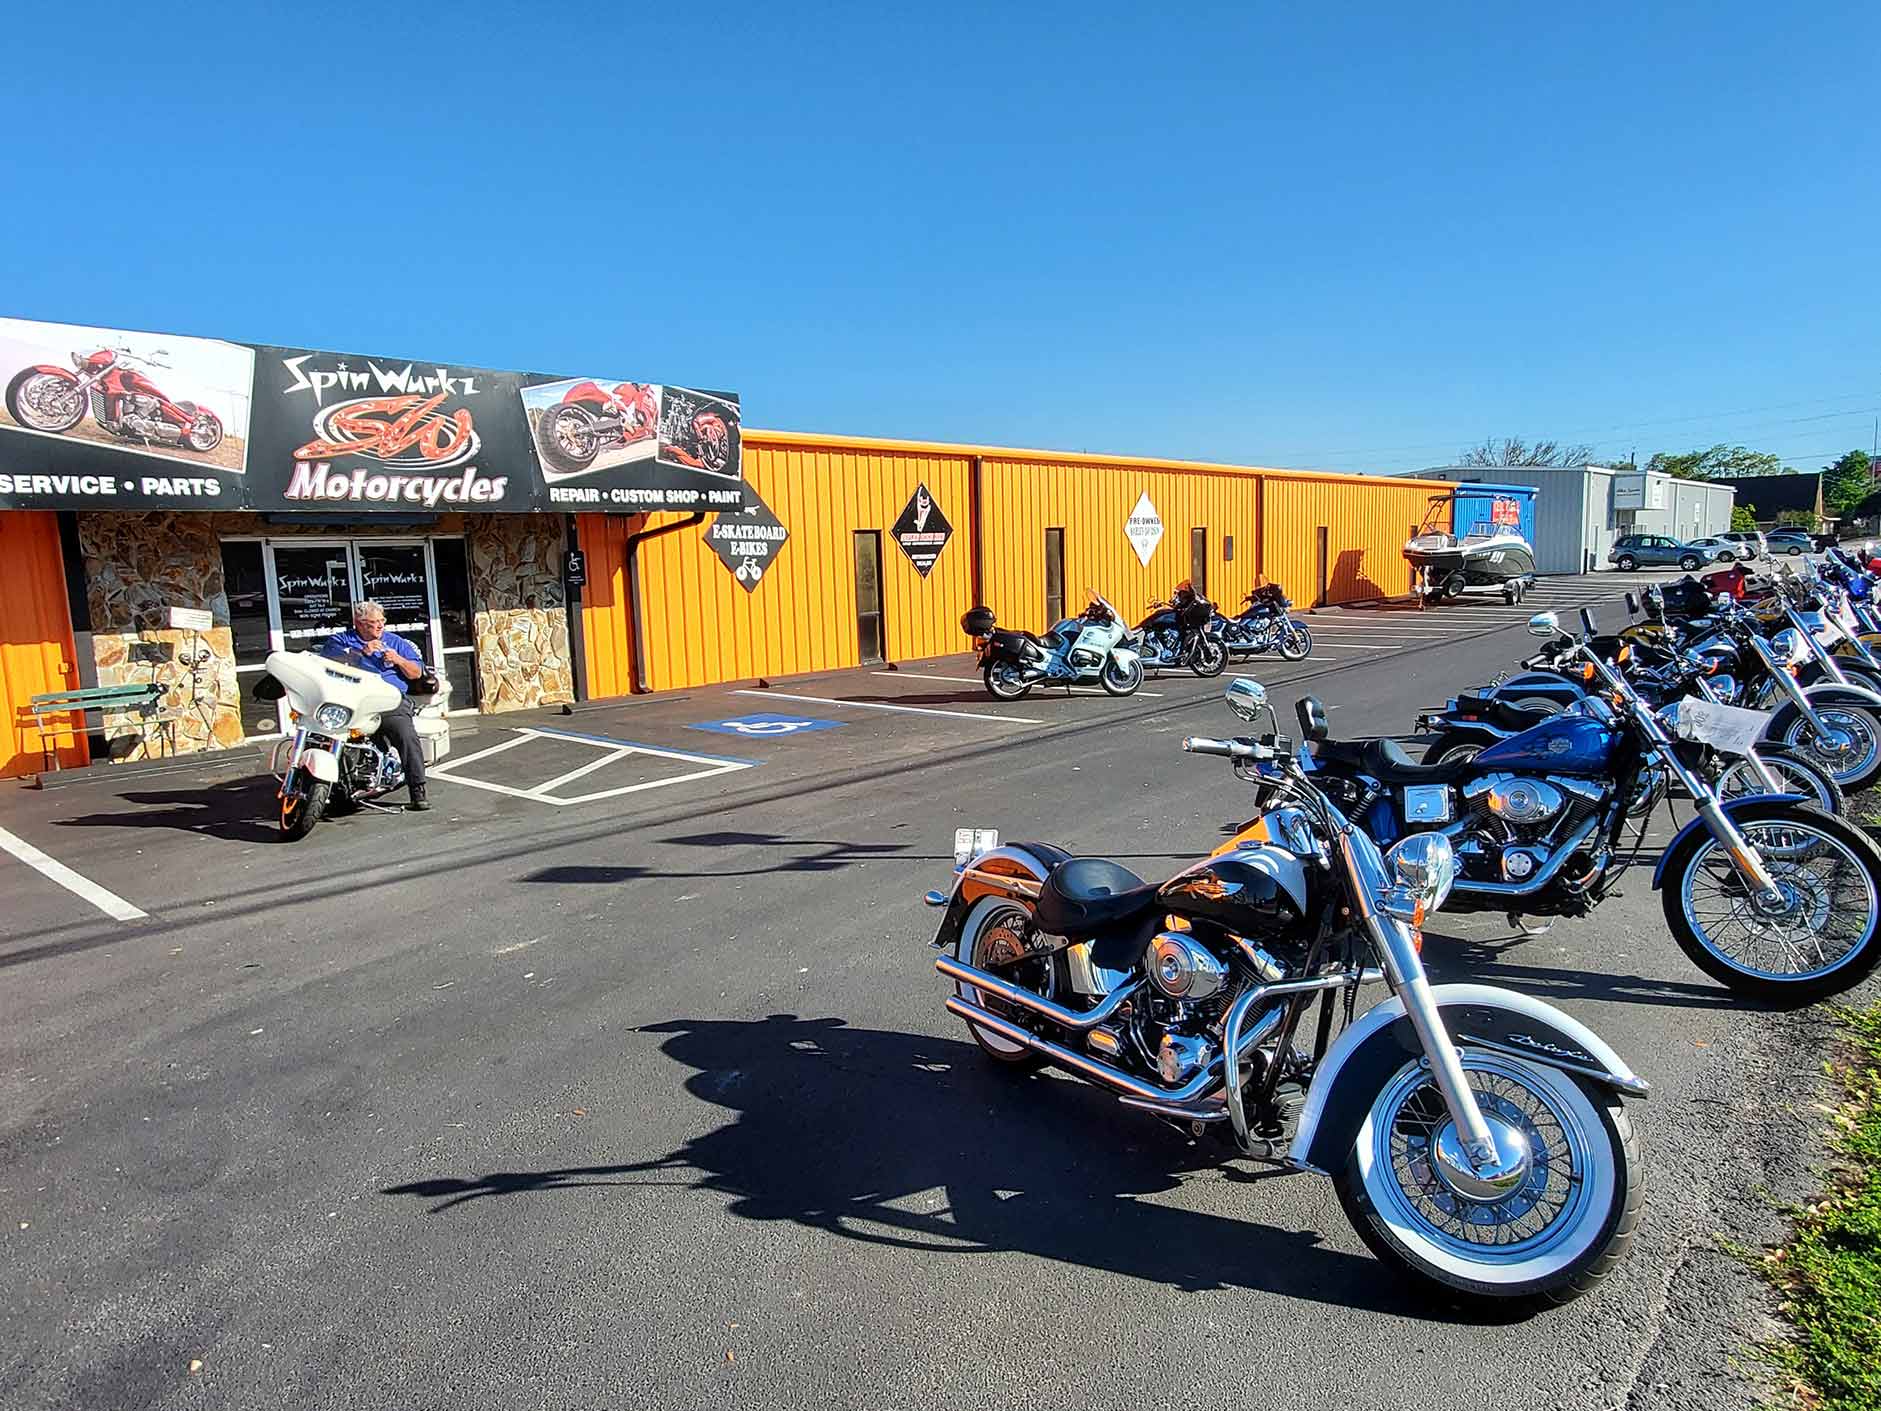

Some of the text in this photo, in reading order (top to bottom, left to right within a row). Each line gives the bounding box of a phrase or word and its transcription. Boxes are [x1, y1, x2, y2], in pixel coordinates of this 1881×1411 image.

[0, 474, 221, 496] SERVICE PARTS
[284, 460, 508, 507] Motorcycles
[550, 487, 741, 504] REPAIR CUSTOM SHOP PAINT
[712, 524, 786, 540] E-SKATEBOARD
[730, 541, 768, 556] E-BIKES
